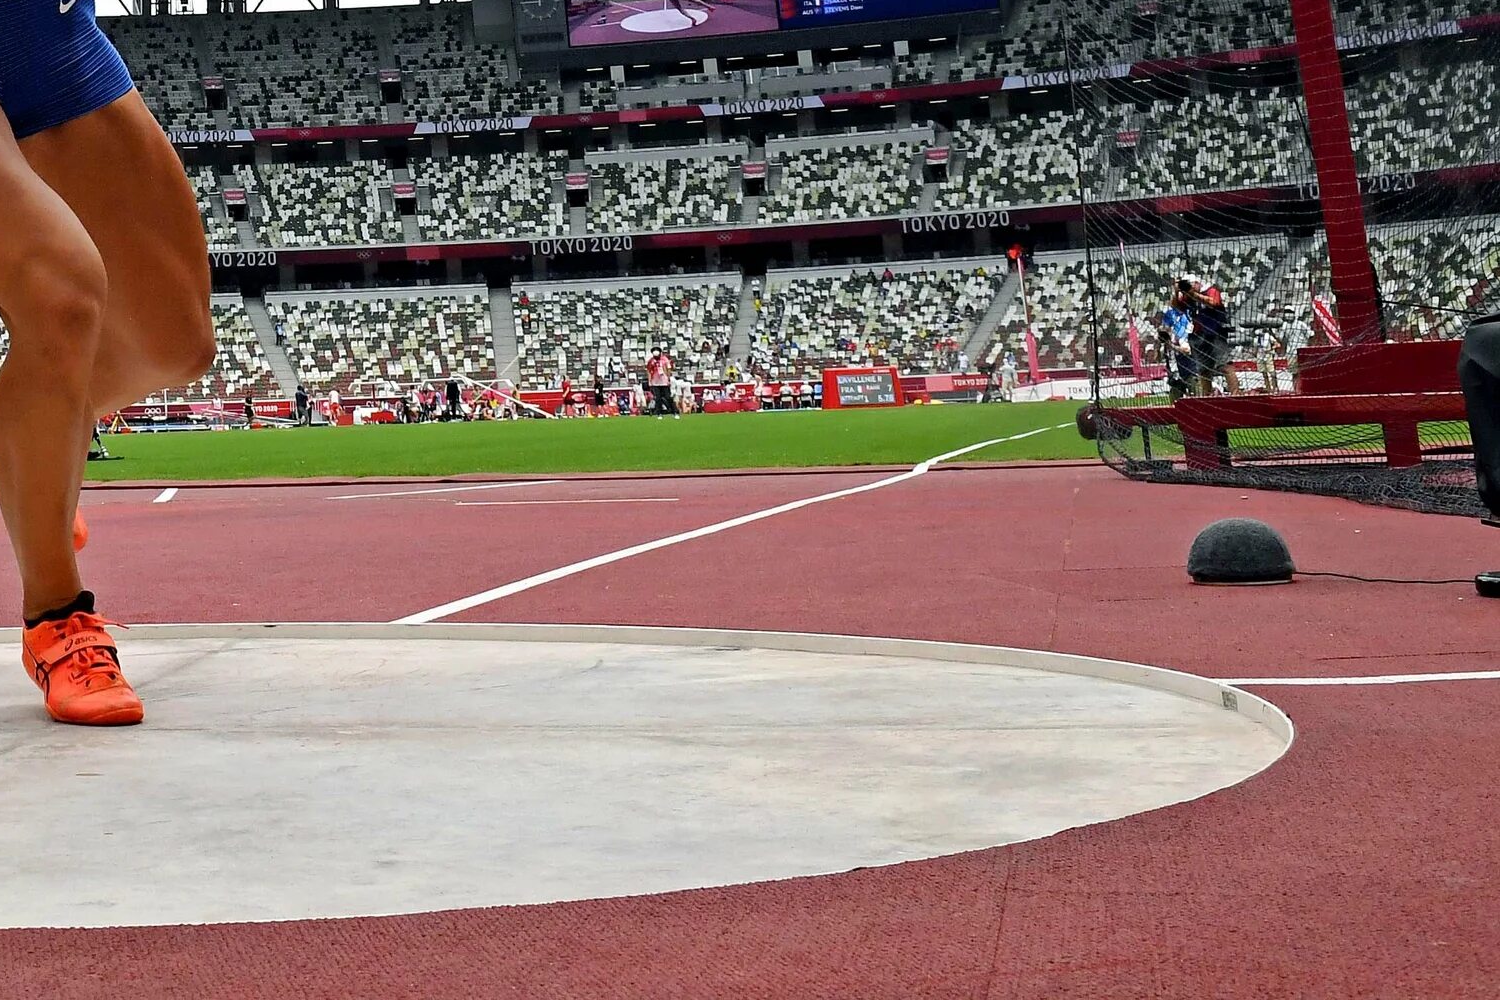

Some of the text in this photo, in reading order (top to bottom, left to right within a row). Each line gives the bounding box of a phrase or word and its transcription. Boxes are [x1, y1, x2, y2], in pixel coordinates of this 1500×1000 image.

[721, 98, 804, 115] TOKYO 2020
[434, 118, 513, 133] TOKYO 2020
[166, 131, 200, 143] OKYO
[900, 211, 1010, 234] TOKYO 2020
[529, 235, 633, 256] TOKYO 2020
[236, 251, 277, 267] 2020
[74, 636, 97, 645] asics
